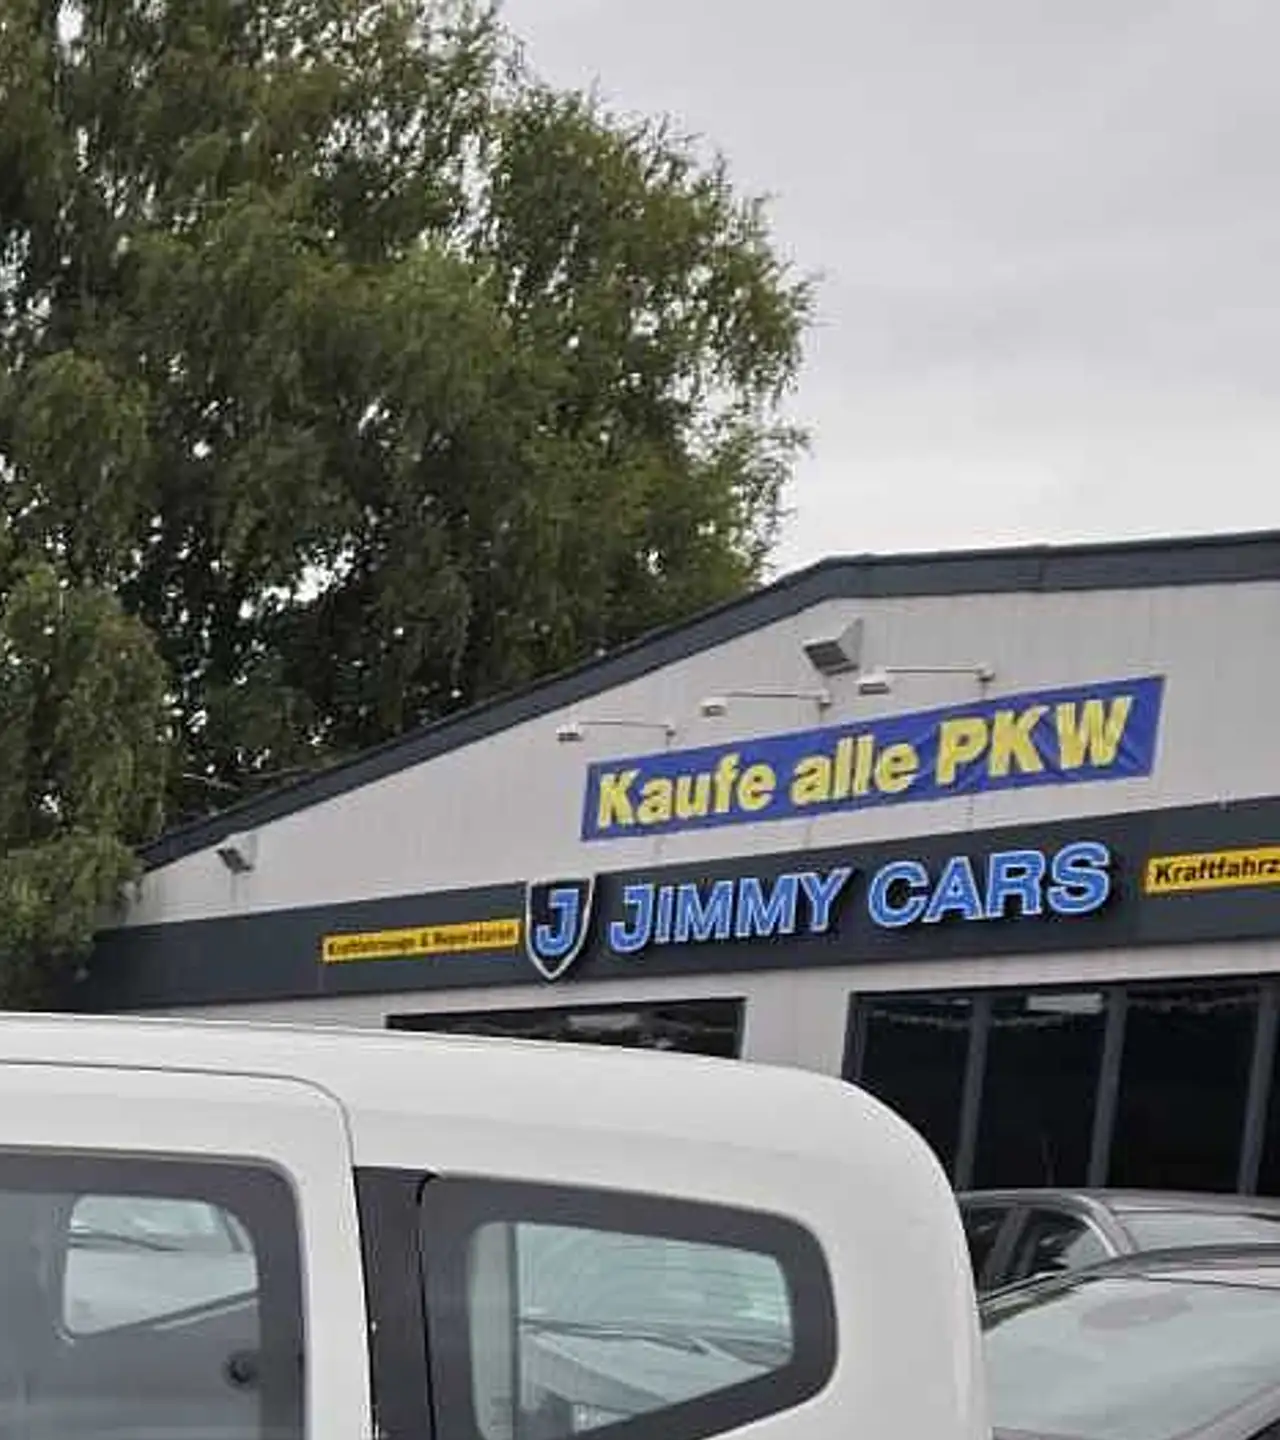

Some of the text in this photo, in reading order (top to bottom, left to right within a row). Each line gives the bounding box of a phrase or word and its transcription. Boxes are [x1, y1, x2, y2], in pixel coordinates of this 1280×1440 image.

[597, 695, 1133, 829] Kaufe alle PKW
[535, 888, 579, 956] J
[609, 841, 1110, 953] JIMMY CARS
